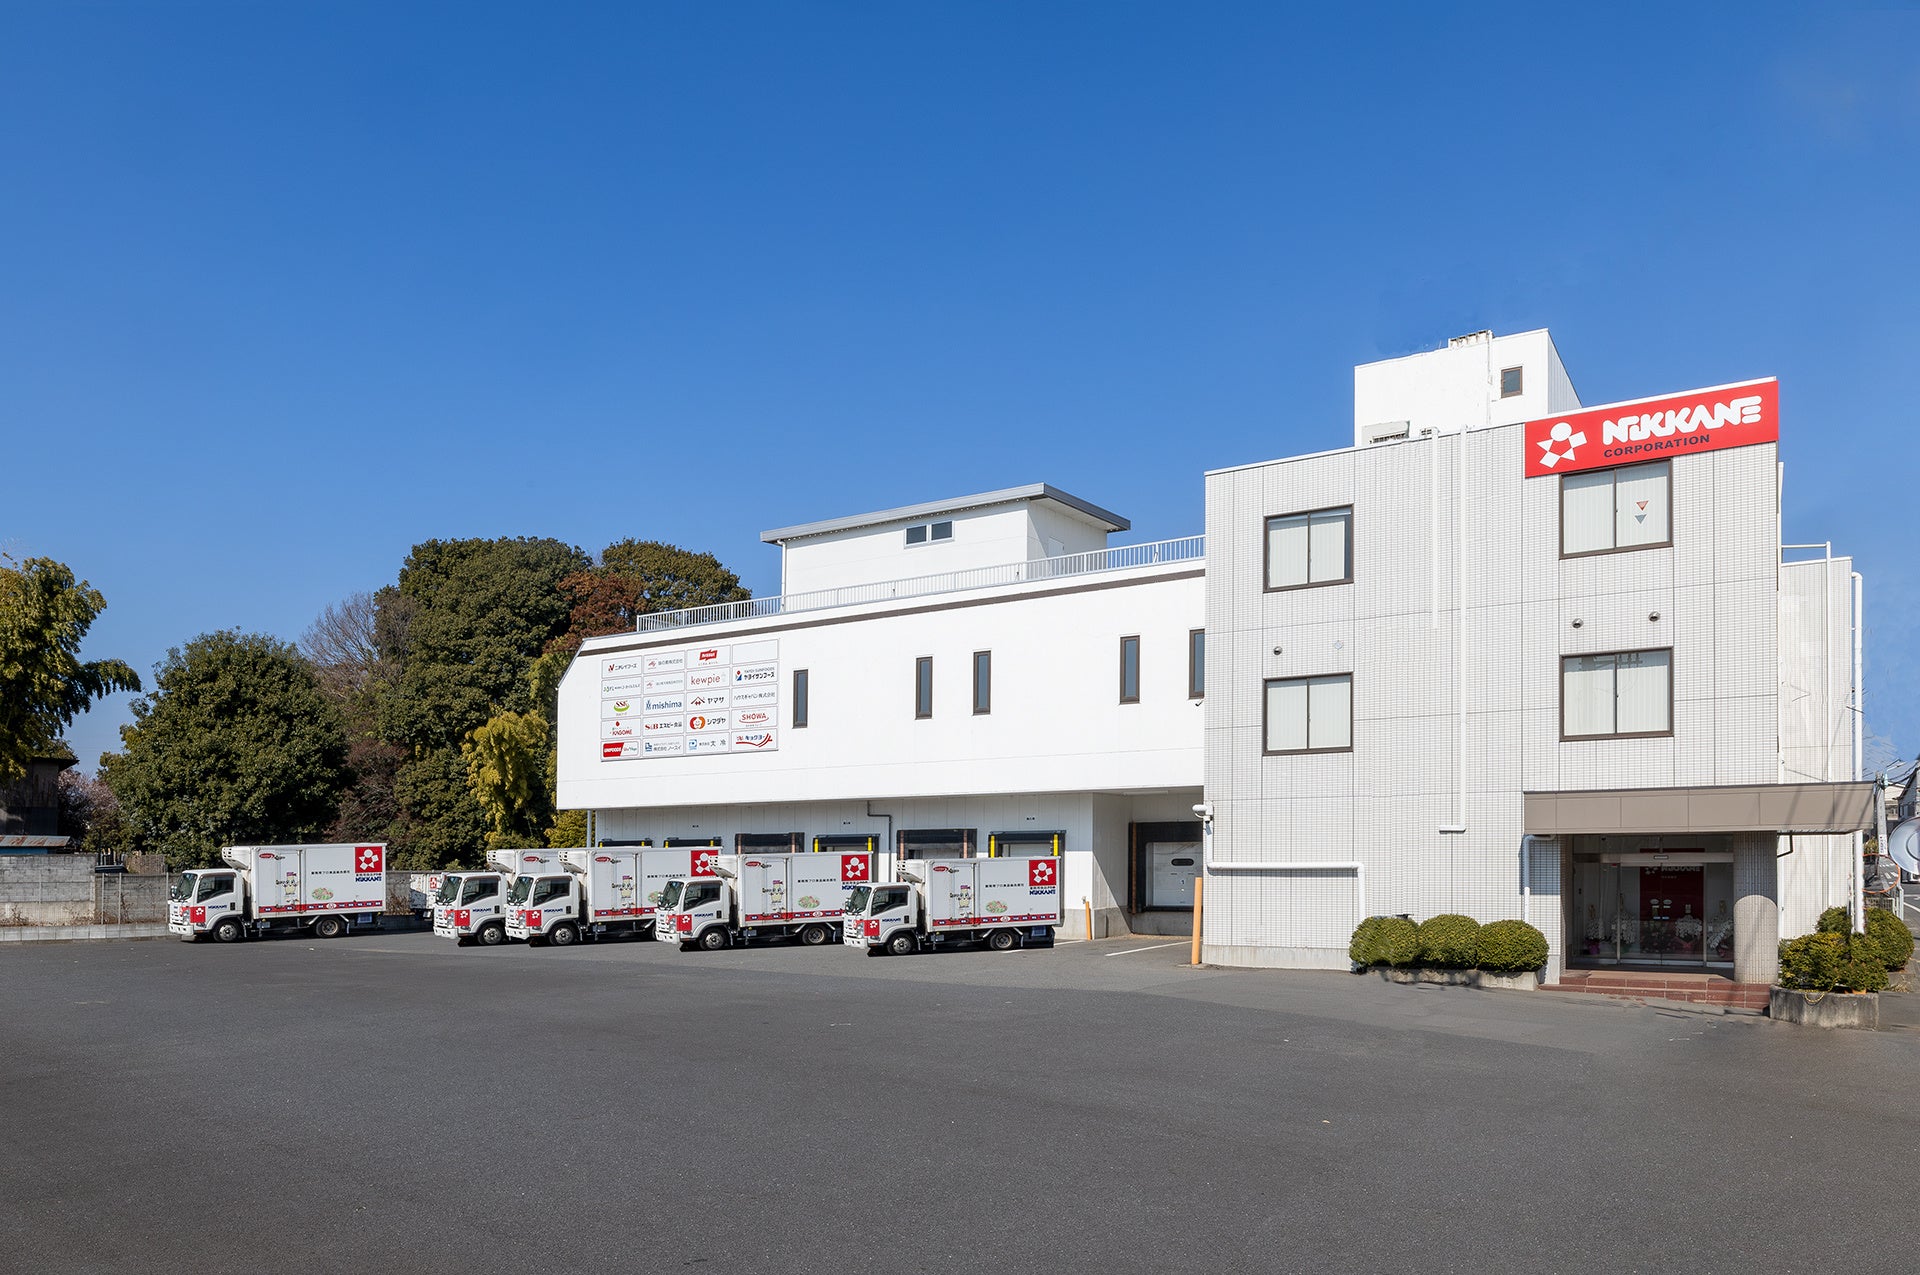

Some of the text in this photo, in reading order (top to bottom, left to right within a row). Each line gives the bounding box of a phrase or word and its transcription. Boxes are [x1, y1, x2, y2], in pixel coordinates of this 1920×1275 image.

[1602, 395, 1762, 445] NIKKANE
[1603, 434, 1710, 458] CORPORATION
[690, 674, 721, 686] kewpie
[707, 696, 724, 704] ヤマサ
[652, 701, 682, 710] mishima
[707, 716, 726, 725] シマダヤ
[742, 713, 767, 721] SHOWA
